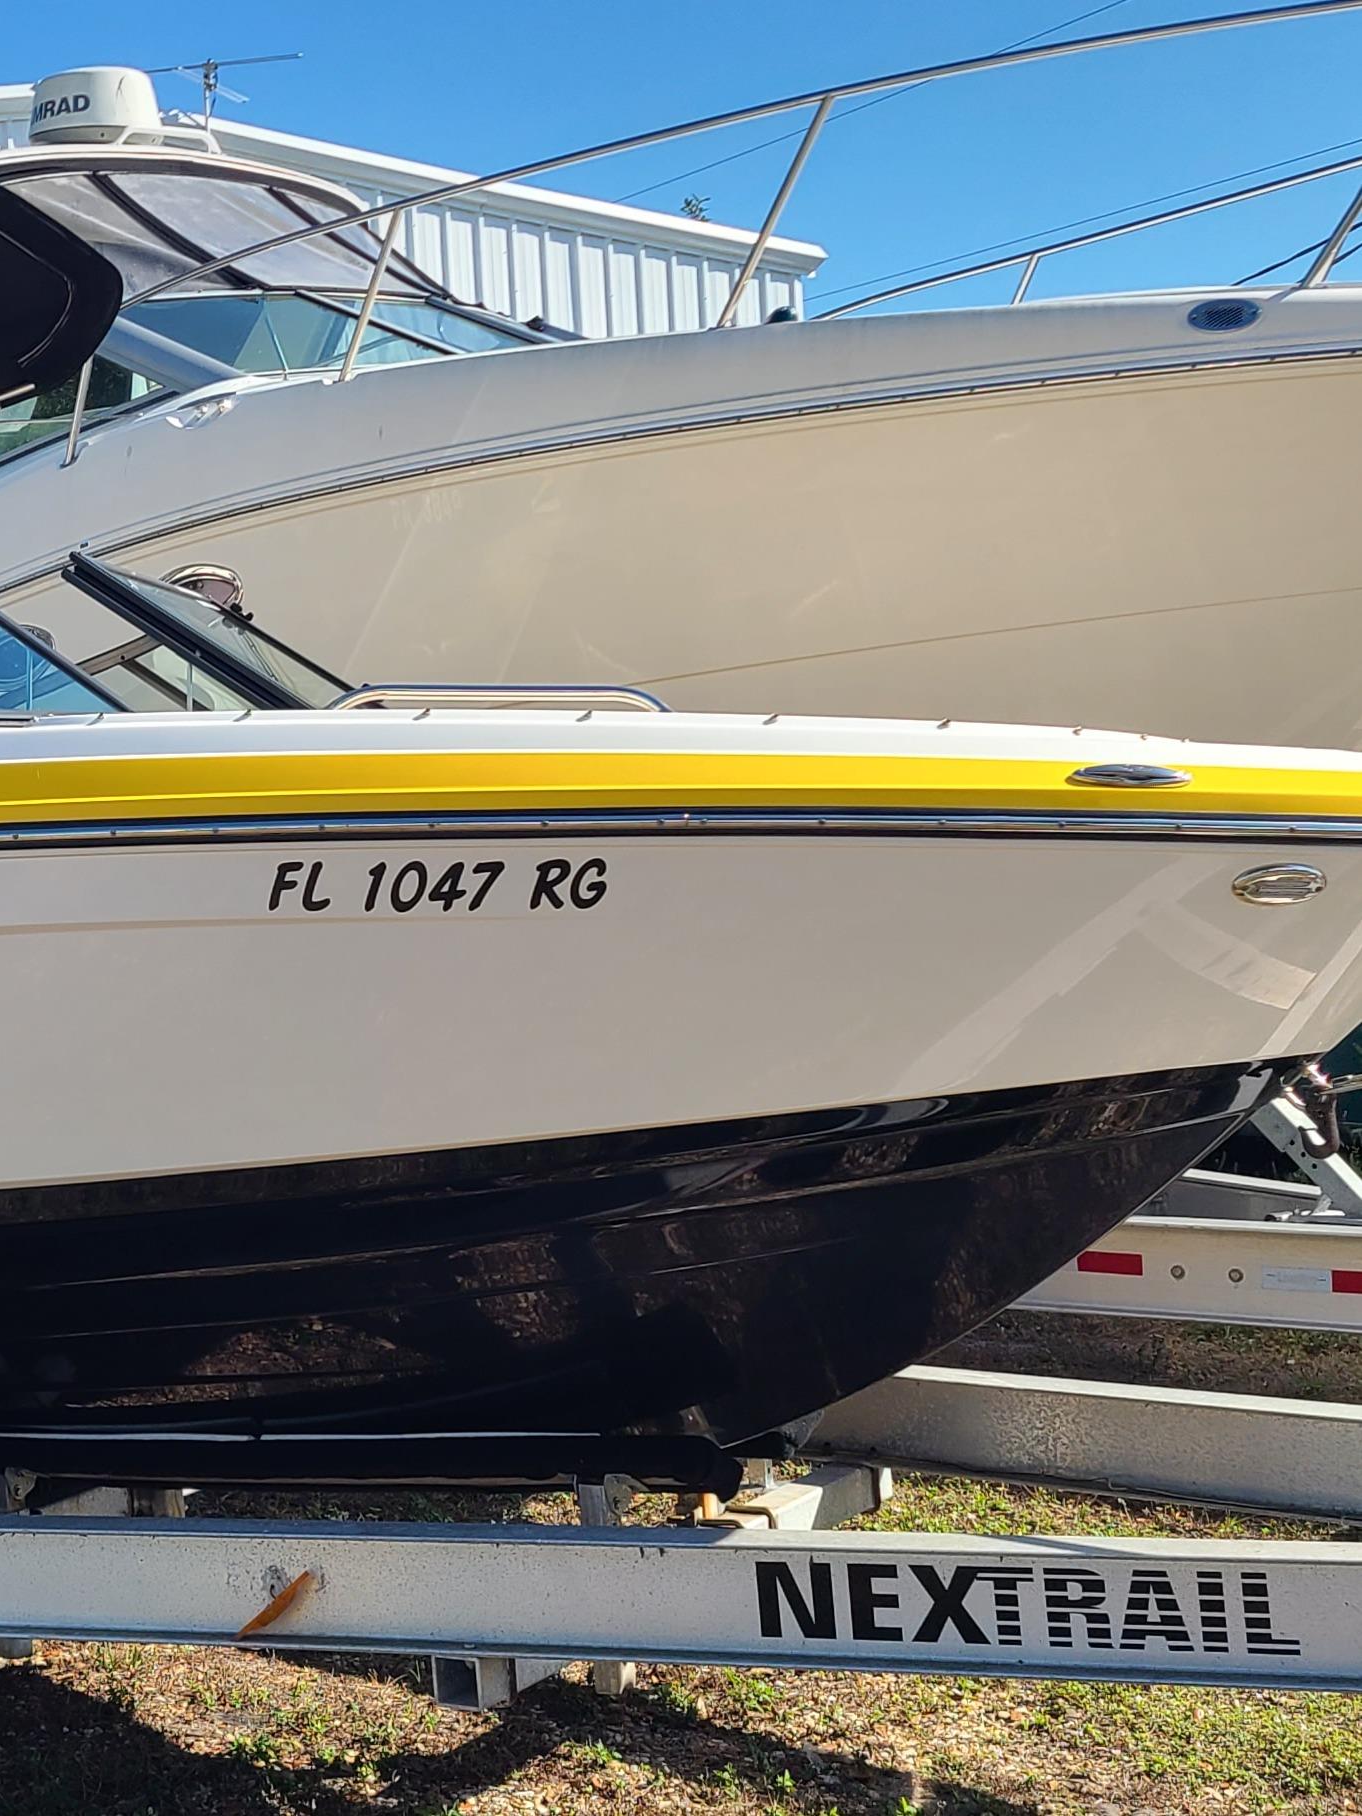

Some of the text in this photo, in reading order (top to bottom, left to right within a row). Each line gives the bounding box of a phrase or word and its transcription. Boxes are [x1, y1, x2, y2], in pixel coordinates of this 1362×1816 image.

[268, 858, 607, 912] FL 1047 RG
[754, 1561, 1302, 1656] NEXTRAIL
